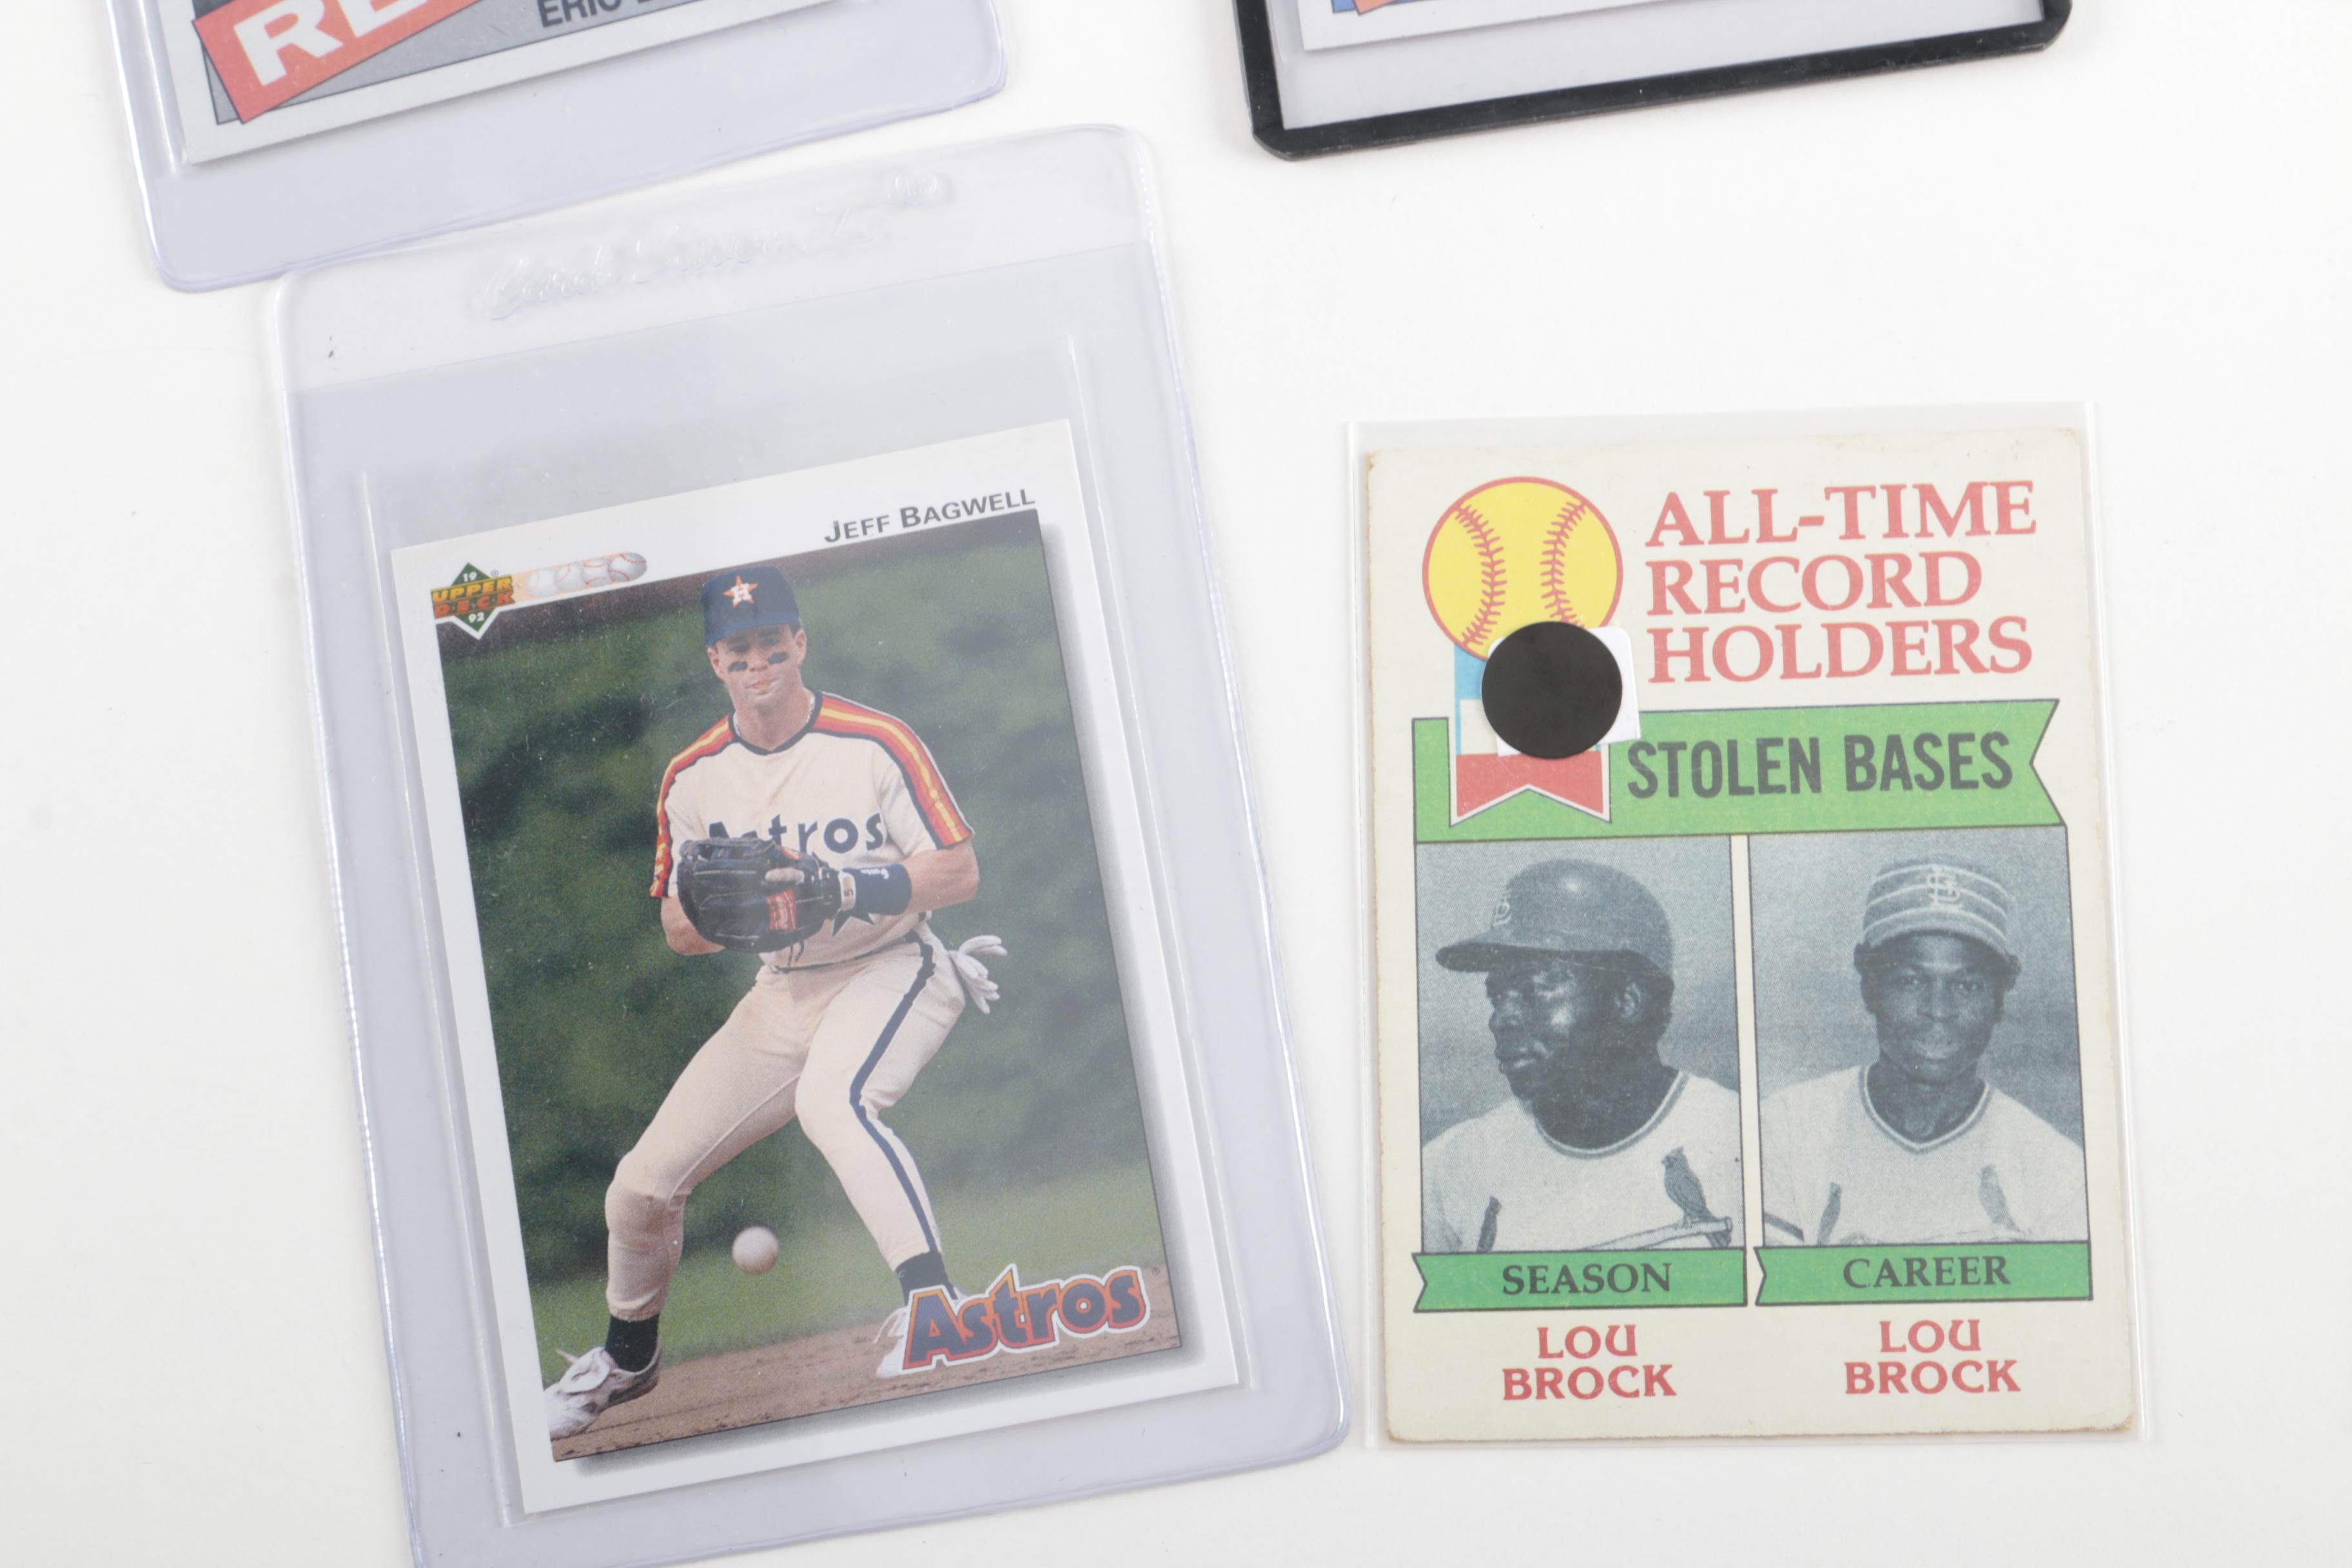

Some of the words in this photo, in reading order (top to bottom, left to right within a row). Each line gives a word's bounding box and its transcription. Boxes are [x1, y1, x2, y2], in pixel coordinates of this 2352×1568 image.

[824, 520, 890, 543] JEFF
[900, 489, 1035, 528] BAGWELL
[1645, 480, 2037, 547] ALL-TIME
[432, 576, 513, 602] UPPER
[462, 571, 477, 582] 19
[1645, 551, 1983, 616] RECORD
[468, 612, 484, 623] 92
[1646, 615, 2033, 683] HOLDERS
[1627, 738, 1822, 799] STOLEN
[1844, 731, 2013, 792] BASES
[709, 812, 884, 854] tros
[1502, 1262, 1671, 1295] SEASON
[1843, 1255, 2010, 1288] CAREER
[902, 1264, 1150, 1373] Astros
[1879, 1319, 1982, 1353] LOU
[1536, 1324, 1638, 1360] LOU
[1502, 1364, 1678, 1401] BROCK
[1845, 1358, 2022, 1395] BROCK
